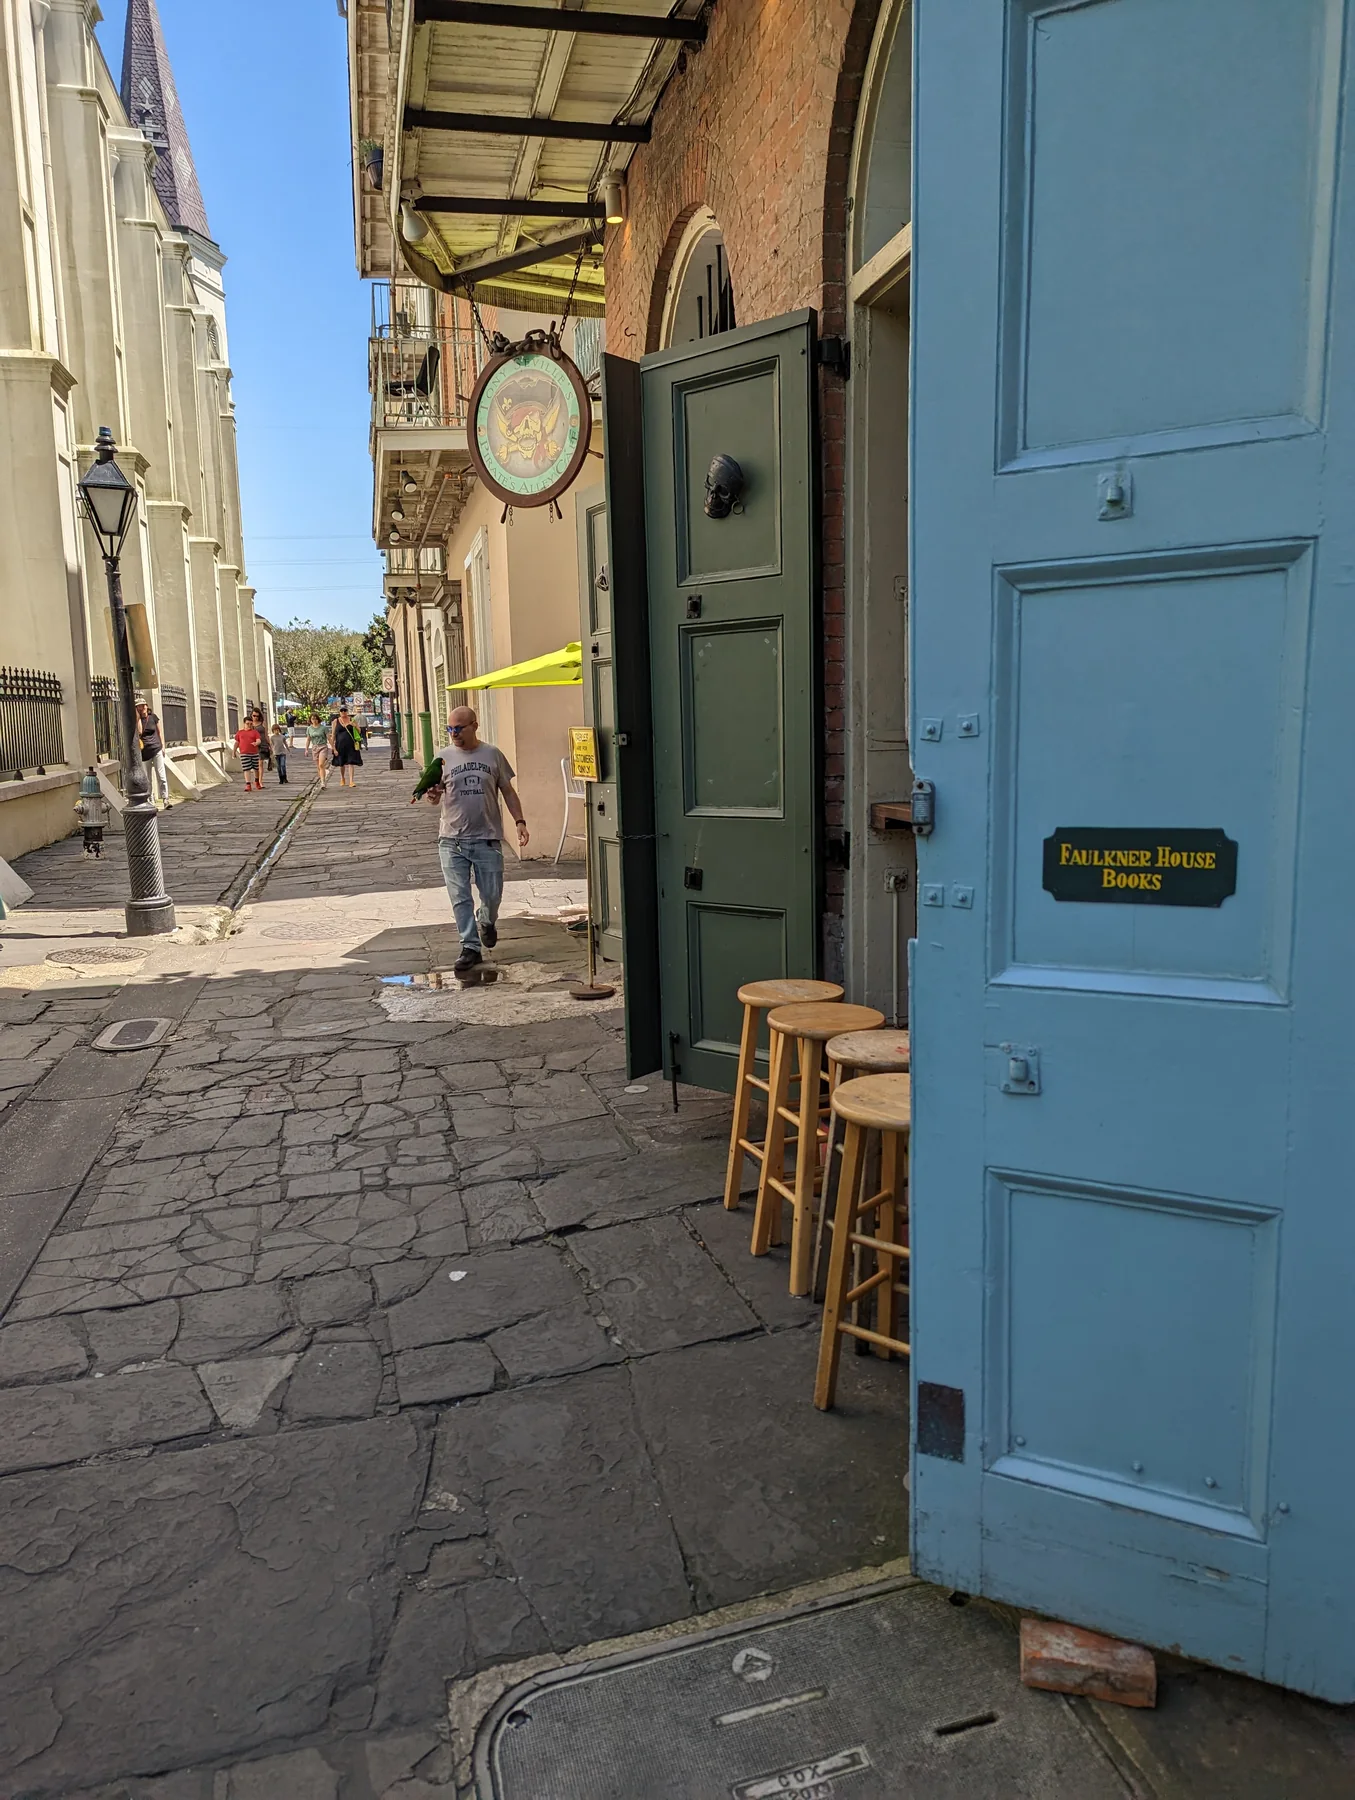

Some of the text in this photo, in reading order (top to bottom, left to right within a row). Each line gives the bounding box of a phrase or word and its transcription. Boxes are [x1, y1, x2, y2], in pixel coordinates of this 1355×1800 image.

[480, 367, 507, 412] TONY
[480, 439, 516, 491] PIRATE'S
[518, 472, 556, 494] ALLEY
[451, 762, 492, 778] PHILADELPHIA
[459, 789, 485, 797] FOOTBALL
[1059, 843, 1216, 870] FAULKNER HOUSE
[1101, 868, 1163, 891] BOOKS
[778, 1764, 822, 1788] COX
